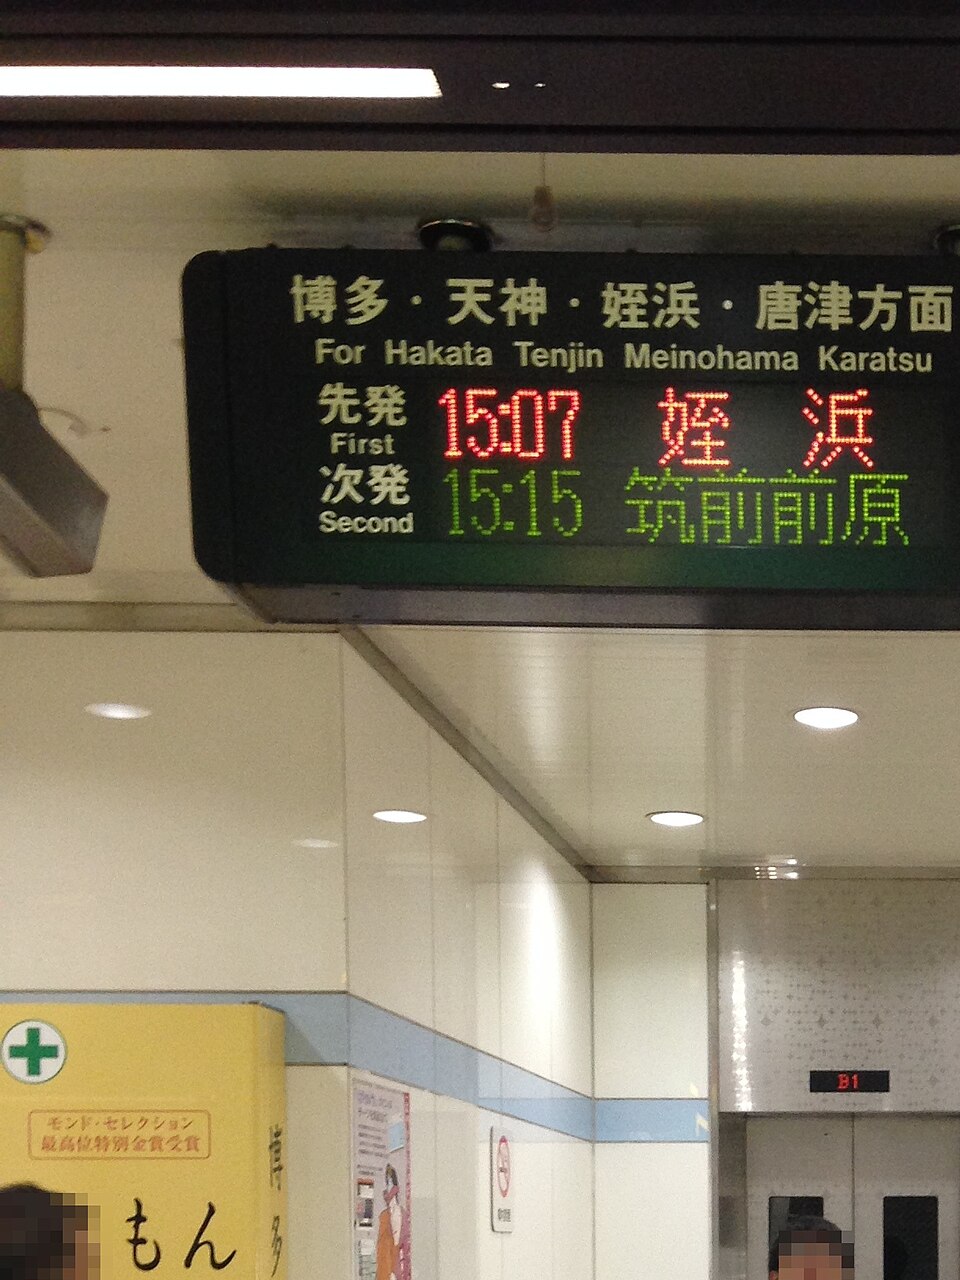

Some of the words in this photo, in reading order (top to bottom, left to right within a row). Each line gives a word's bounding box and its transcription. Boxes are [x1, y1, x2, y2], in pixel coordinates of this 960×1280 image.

[314, 338, 366, 365] For
[383, 338, 494, 367] Hakata
[512, 340, 604, 373] Tenjin
[624, 342, 800, 371] Meinohama
[818, 345, 933, 373] Karatsu
[317, 381, 408, 427] 先発
[438, 387, 583, 461] 15:07
[329, 431, 396, 455] First
[318, 462, 411, 506] 次発
[443, 467, 584, 537] 15:15
[624, 466, 910, 546] 筑前前原
[318, 510, 415, 534] Second
[837, 1072, 859, 1090] B1
[126, 1197, 238, 1273] もん
